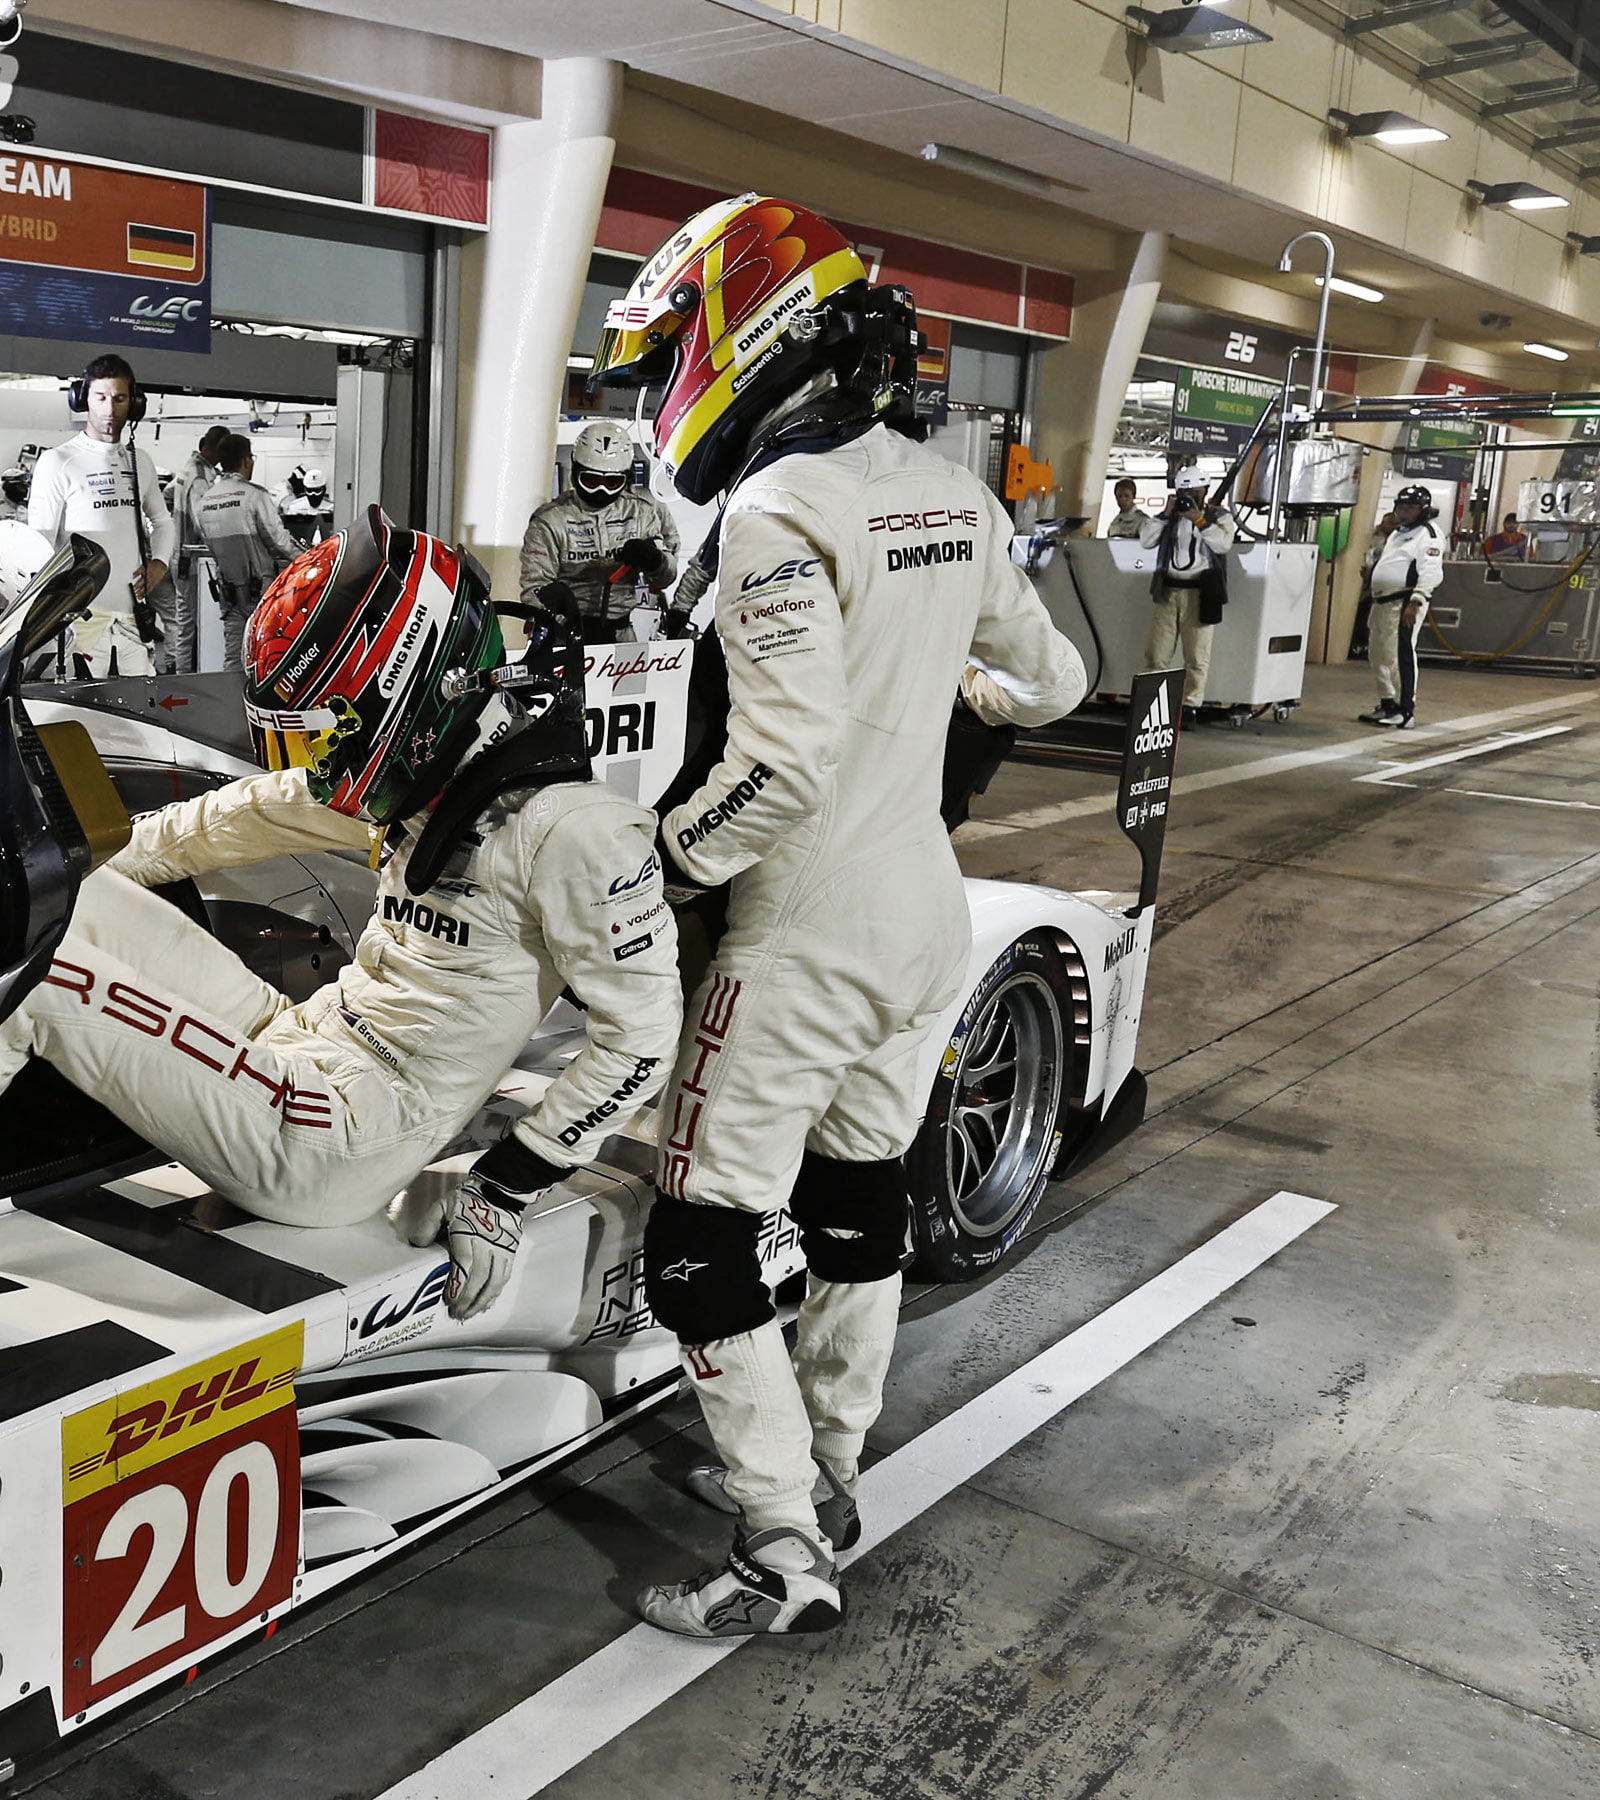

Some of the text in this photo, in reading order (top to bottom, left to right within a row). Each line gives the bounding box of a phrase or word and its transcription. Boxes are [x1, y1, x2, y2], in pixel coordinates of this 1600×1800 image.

[129, 295, 203, 322] WEC
[737, 285, 812, 354] DMG MORI
[1224, 331, 1258, 363] 26
[1191, 370, 1246, 396] PORSCHE TEAM
[1177, 388, 1190, 413] 91
[93, 499, 118, 510] DMG
[1540, 492, 1572, 514] 91
[868, 509, 978, 532] PORSCHE
[567, 550, 599, 561] DMG
[741, 558, 821, 592] WEC
[1569, 574, 1585, 590] 91
[753, 599, 815, 620] vodafone
[383, 603, 428, 692] DMG MORI
[758, 638, 798, 652] Mannheim
[777, 625, 809, 639] Zentrum
[288, 641, 322, 683] Hooker
[597, 647, 686, 691] hybrid
[1134, 724, 1175, 755] adidas
[1129, 776, 1169, 797] SCHAEFFLER
[1150, 801, 1167, 818] FAG
[384, 895, 470, 948] MORI
[620, 940, 648, 956] Giltrap
[1104, 931, 1126, 973] Mobil
[962, 949, 1012, 1029] MICHELIN
[357, 1022, 399, 1067] Brendon
[558, 1100, 620, 1148] DMG
[376, 1313, 436, 1346] ENDURANCE
[101, 1357, 270, 1468] DHL
[90, 1440, 280, 1687] 20
